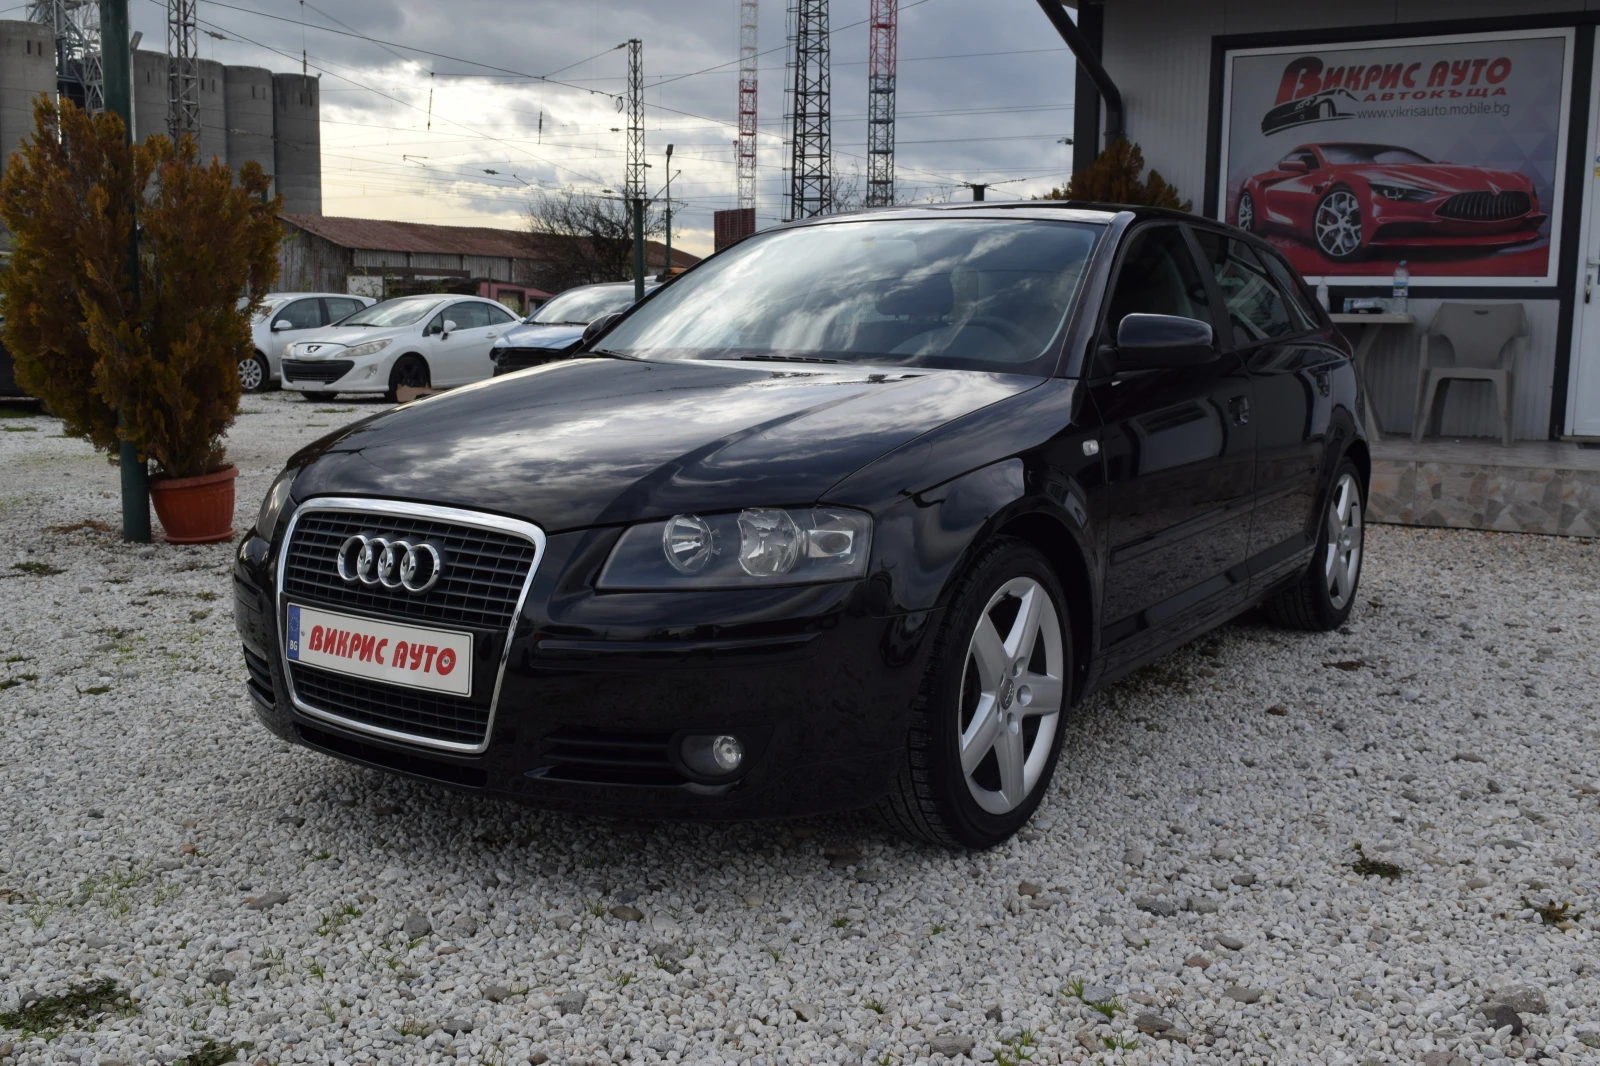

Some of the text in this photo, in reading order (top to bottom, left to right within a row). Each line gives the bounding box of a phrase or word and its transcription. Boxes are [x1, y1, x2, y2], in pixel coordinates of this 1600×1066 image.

[1274, 56, 1512, 106] ВИКРИС АУТО
[1362, 87, 1508, 103] АВТОКЪЩА
[1357, 101, 1511, 119] www.vikrisauto.mobile.bg
[289, 640, 298, 651] BG
[308, 625, 457, 676] ВИКРИС АУТО
